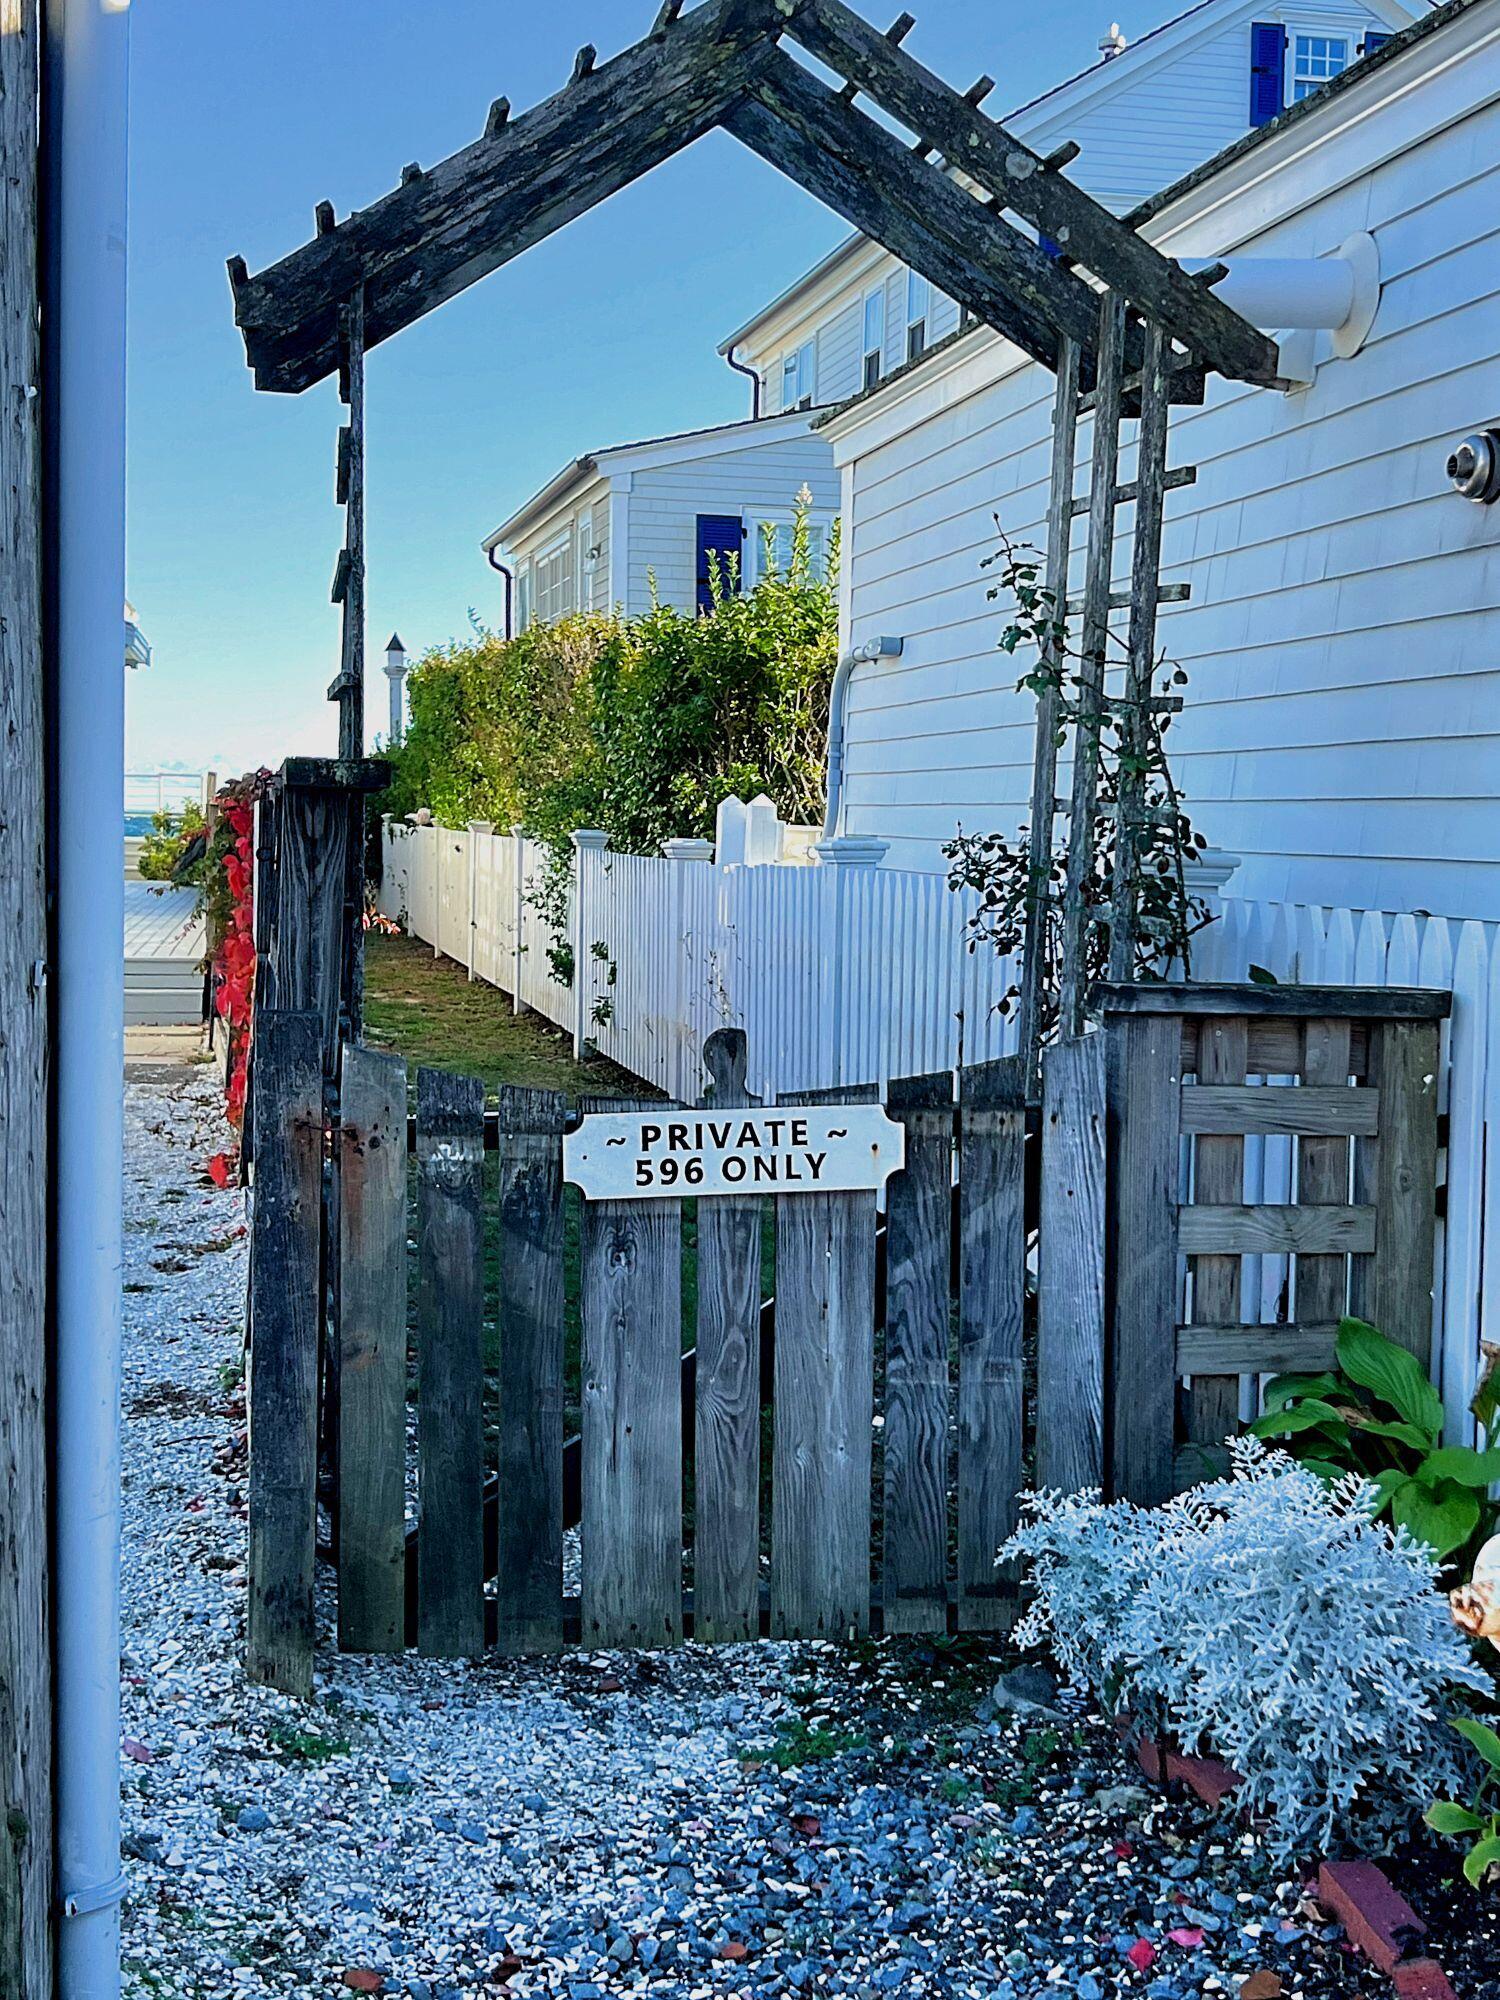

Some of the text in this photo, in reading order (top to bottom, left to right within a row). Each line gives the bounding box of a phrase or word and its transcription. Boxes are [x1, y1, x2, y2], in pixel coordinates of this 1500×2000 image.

[641, 1119, 808, 1152] PRIVATE
[635, 1152, 827, 1187] 596 ONLY
